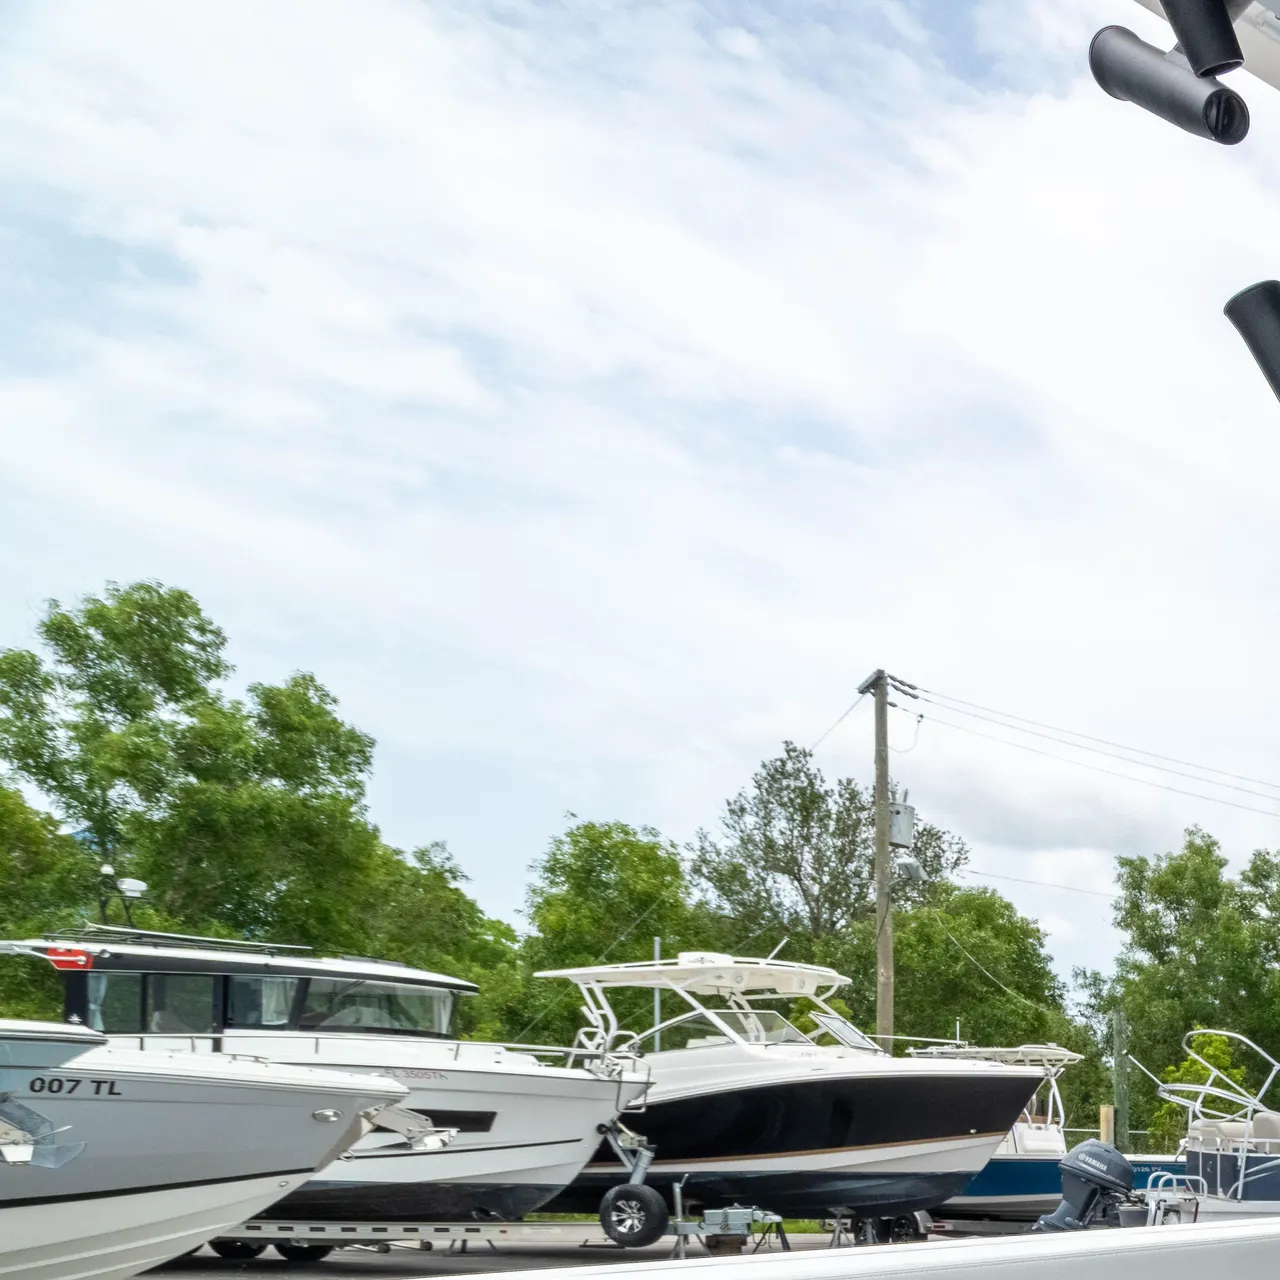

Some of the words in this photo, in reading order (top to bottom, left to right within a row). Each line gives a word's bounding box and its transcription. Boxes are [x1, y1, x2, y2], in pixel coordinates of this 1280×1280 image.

[29, 1076, 83, 1094] 007
[89, 1080, 122, 1096] TL
[1085, 1155, 1108, 1172] YAMAHA
